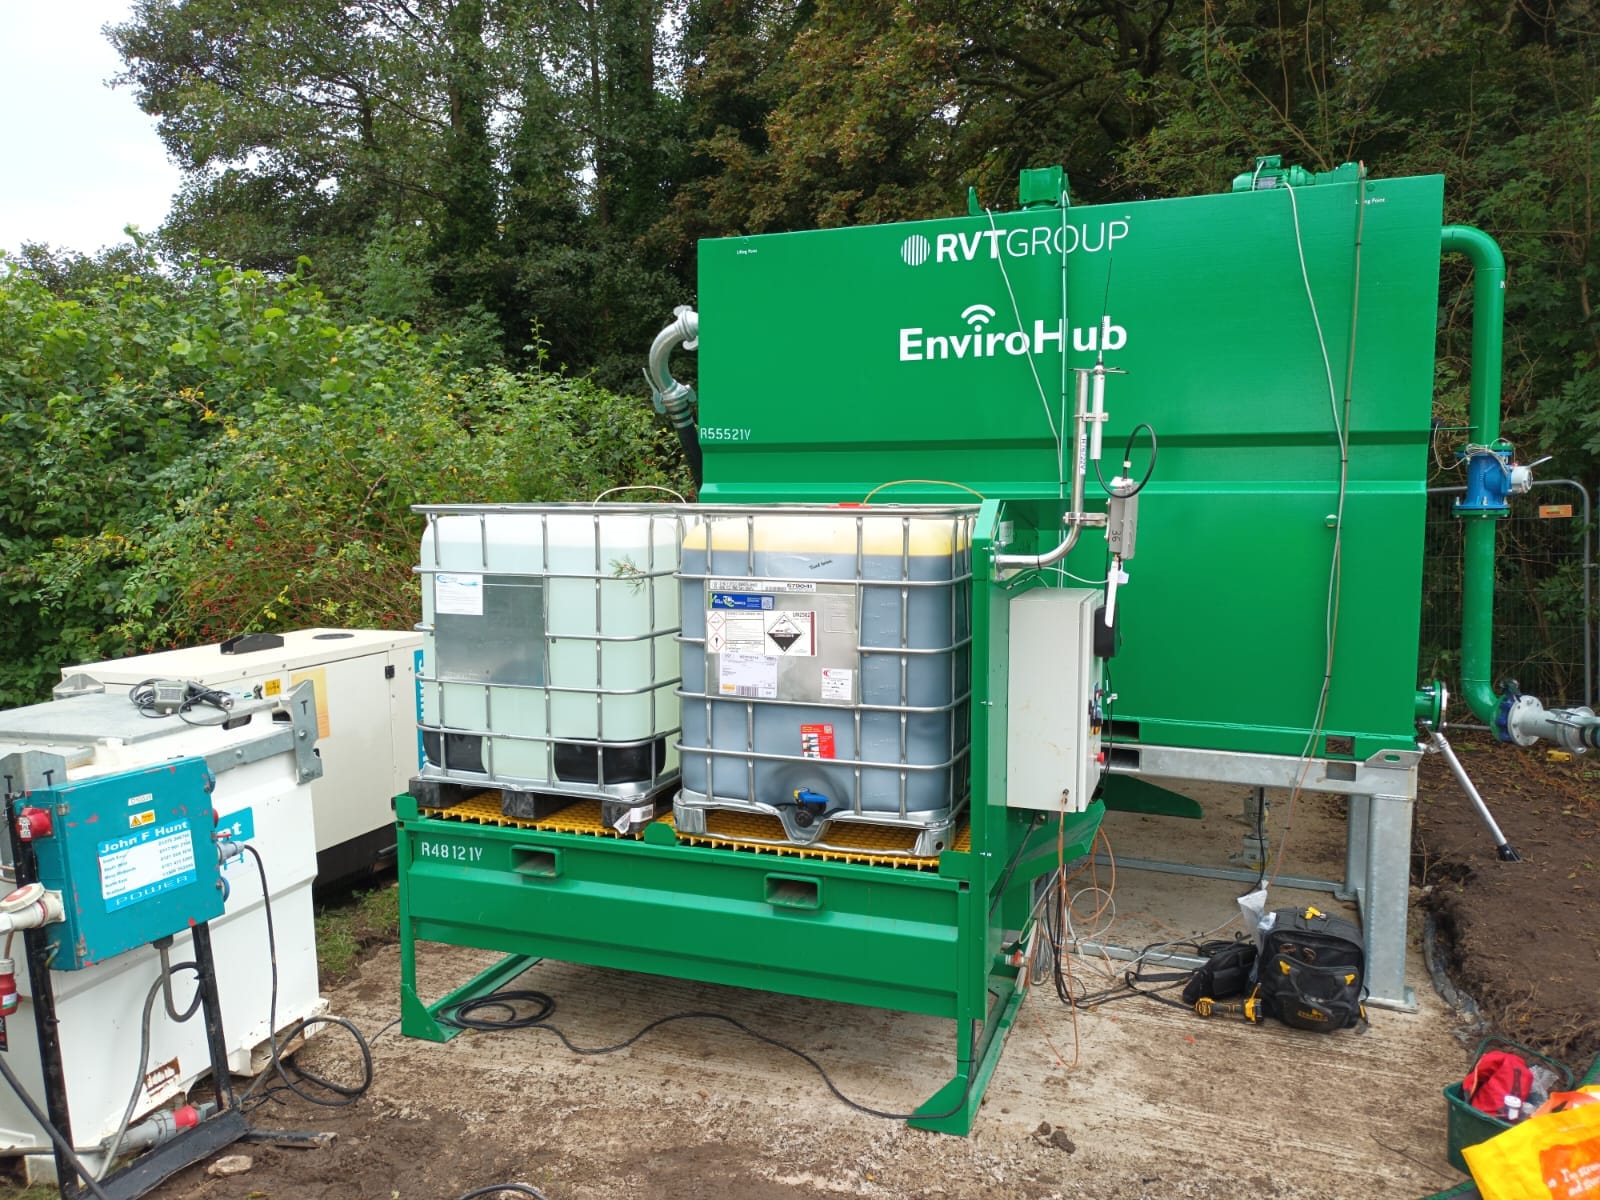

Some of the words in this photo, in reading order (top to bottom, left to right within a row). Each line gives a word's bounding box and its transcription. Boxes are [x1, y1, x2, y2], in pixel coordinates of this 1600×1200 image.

[900, 315, 1128, 361] EnviroHub
[700, 427, 751, 440] R55521V
[101, 837, 138, 853] John
[141, 831, 150, 841] F
[155, 821, 188, 837] Hunt
[421, 841, 483, 861] R48121V
